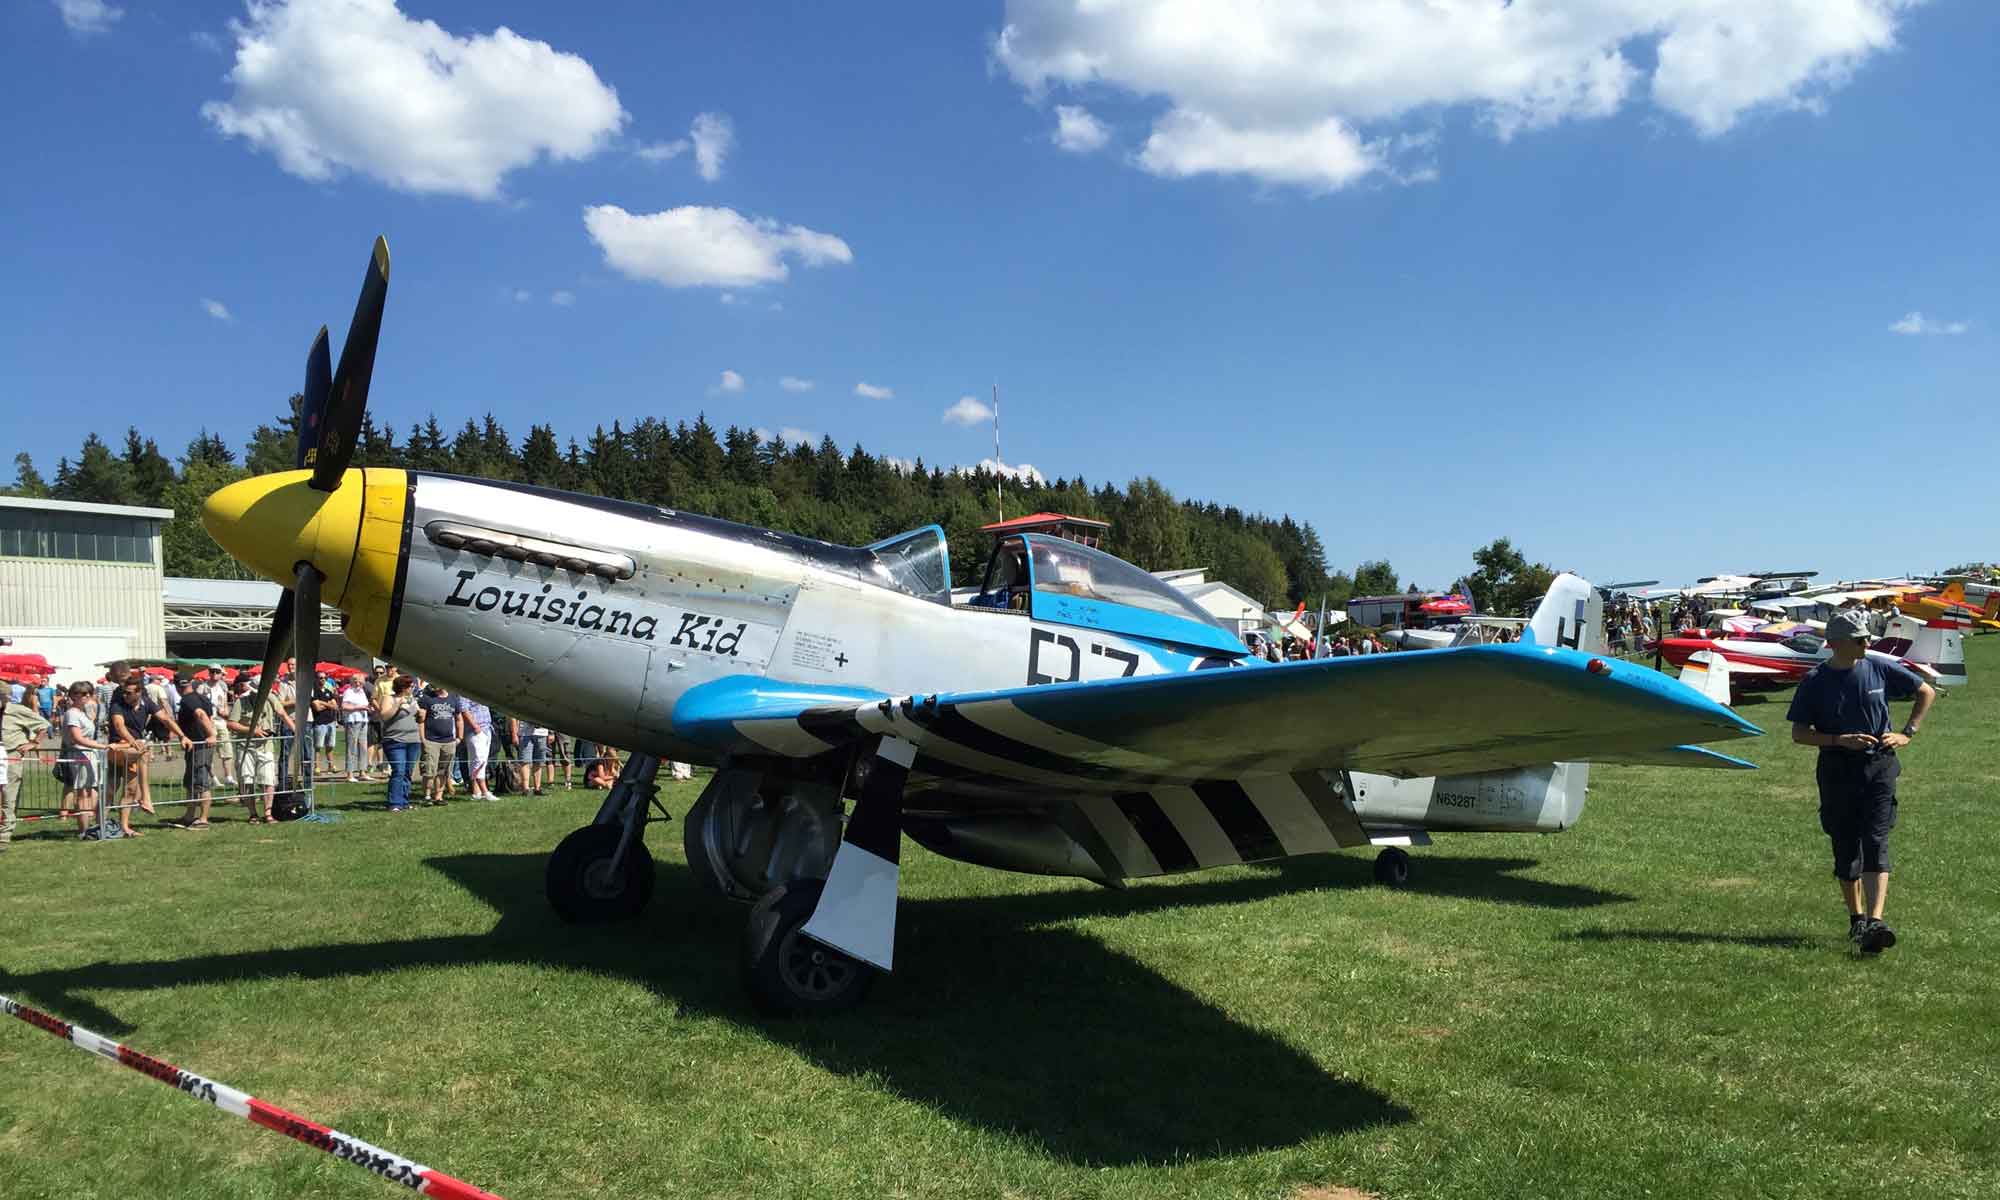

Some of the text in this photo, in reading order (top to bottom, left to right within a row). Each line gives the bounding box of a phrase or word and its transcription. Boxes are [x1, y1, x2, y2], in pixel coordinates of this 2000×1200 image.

[444, 570, 658, 641] Louisiana
[670, 612, 747, 656] Kid
[1556, 599, 1585, 651] H
[1436, 791, 1476, 809] N6328T
